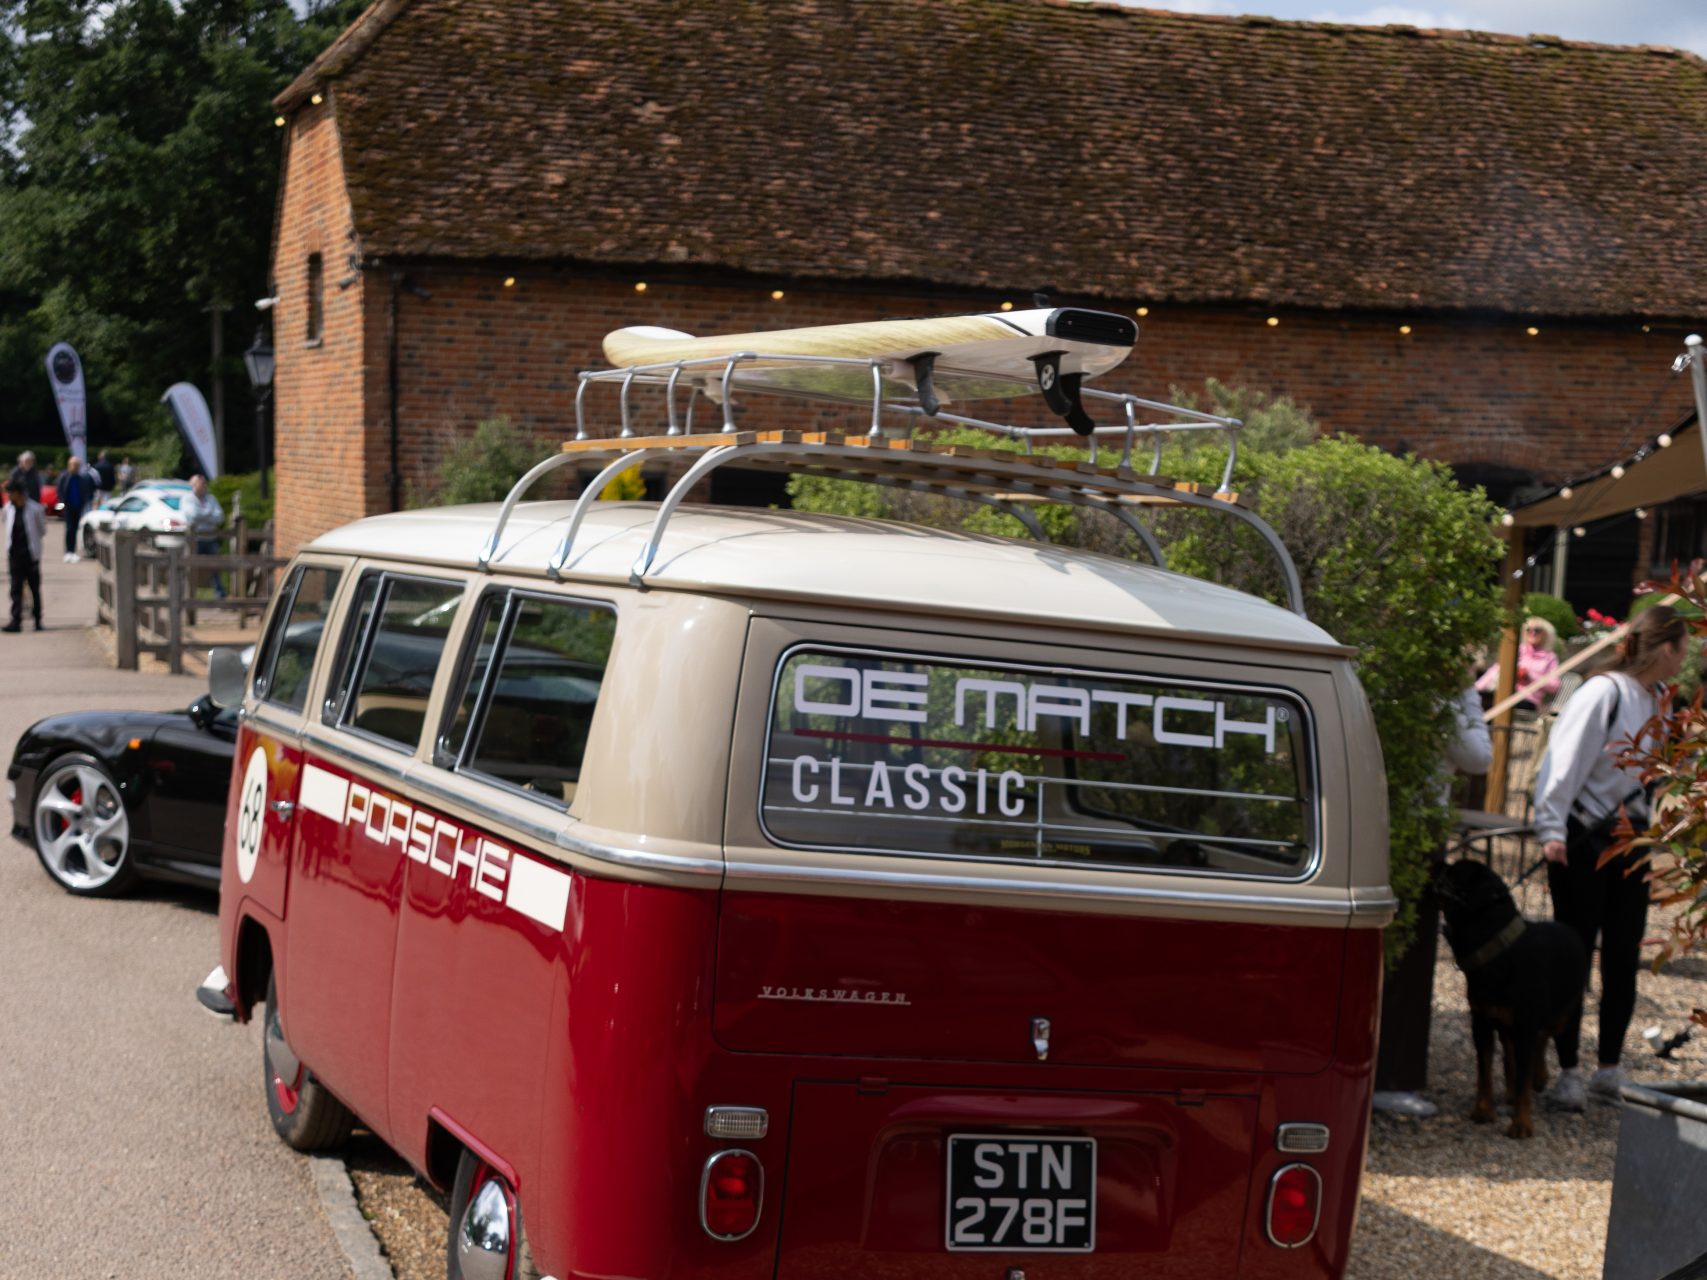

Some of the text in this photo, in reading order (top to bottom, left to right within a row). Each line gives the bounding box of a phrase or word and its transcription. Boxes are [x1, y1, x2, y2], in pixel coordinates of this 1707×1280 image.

[794, 664, 929, 723] OE
[239, 774, 263, 856] 68
[791, 755, 1026, 817] CLASSIC
[345, 783, 510, 902] PORSCHE
[762, 986, 906, 1004] VOLKSWAGEN
[974, 1143, 1072, 1189] STN
[954, 1197, 1087, 1244] 278F
